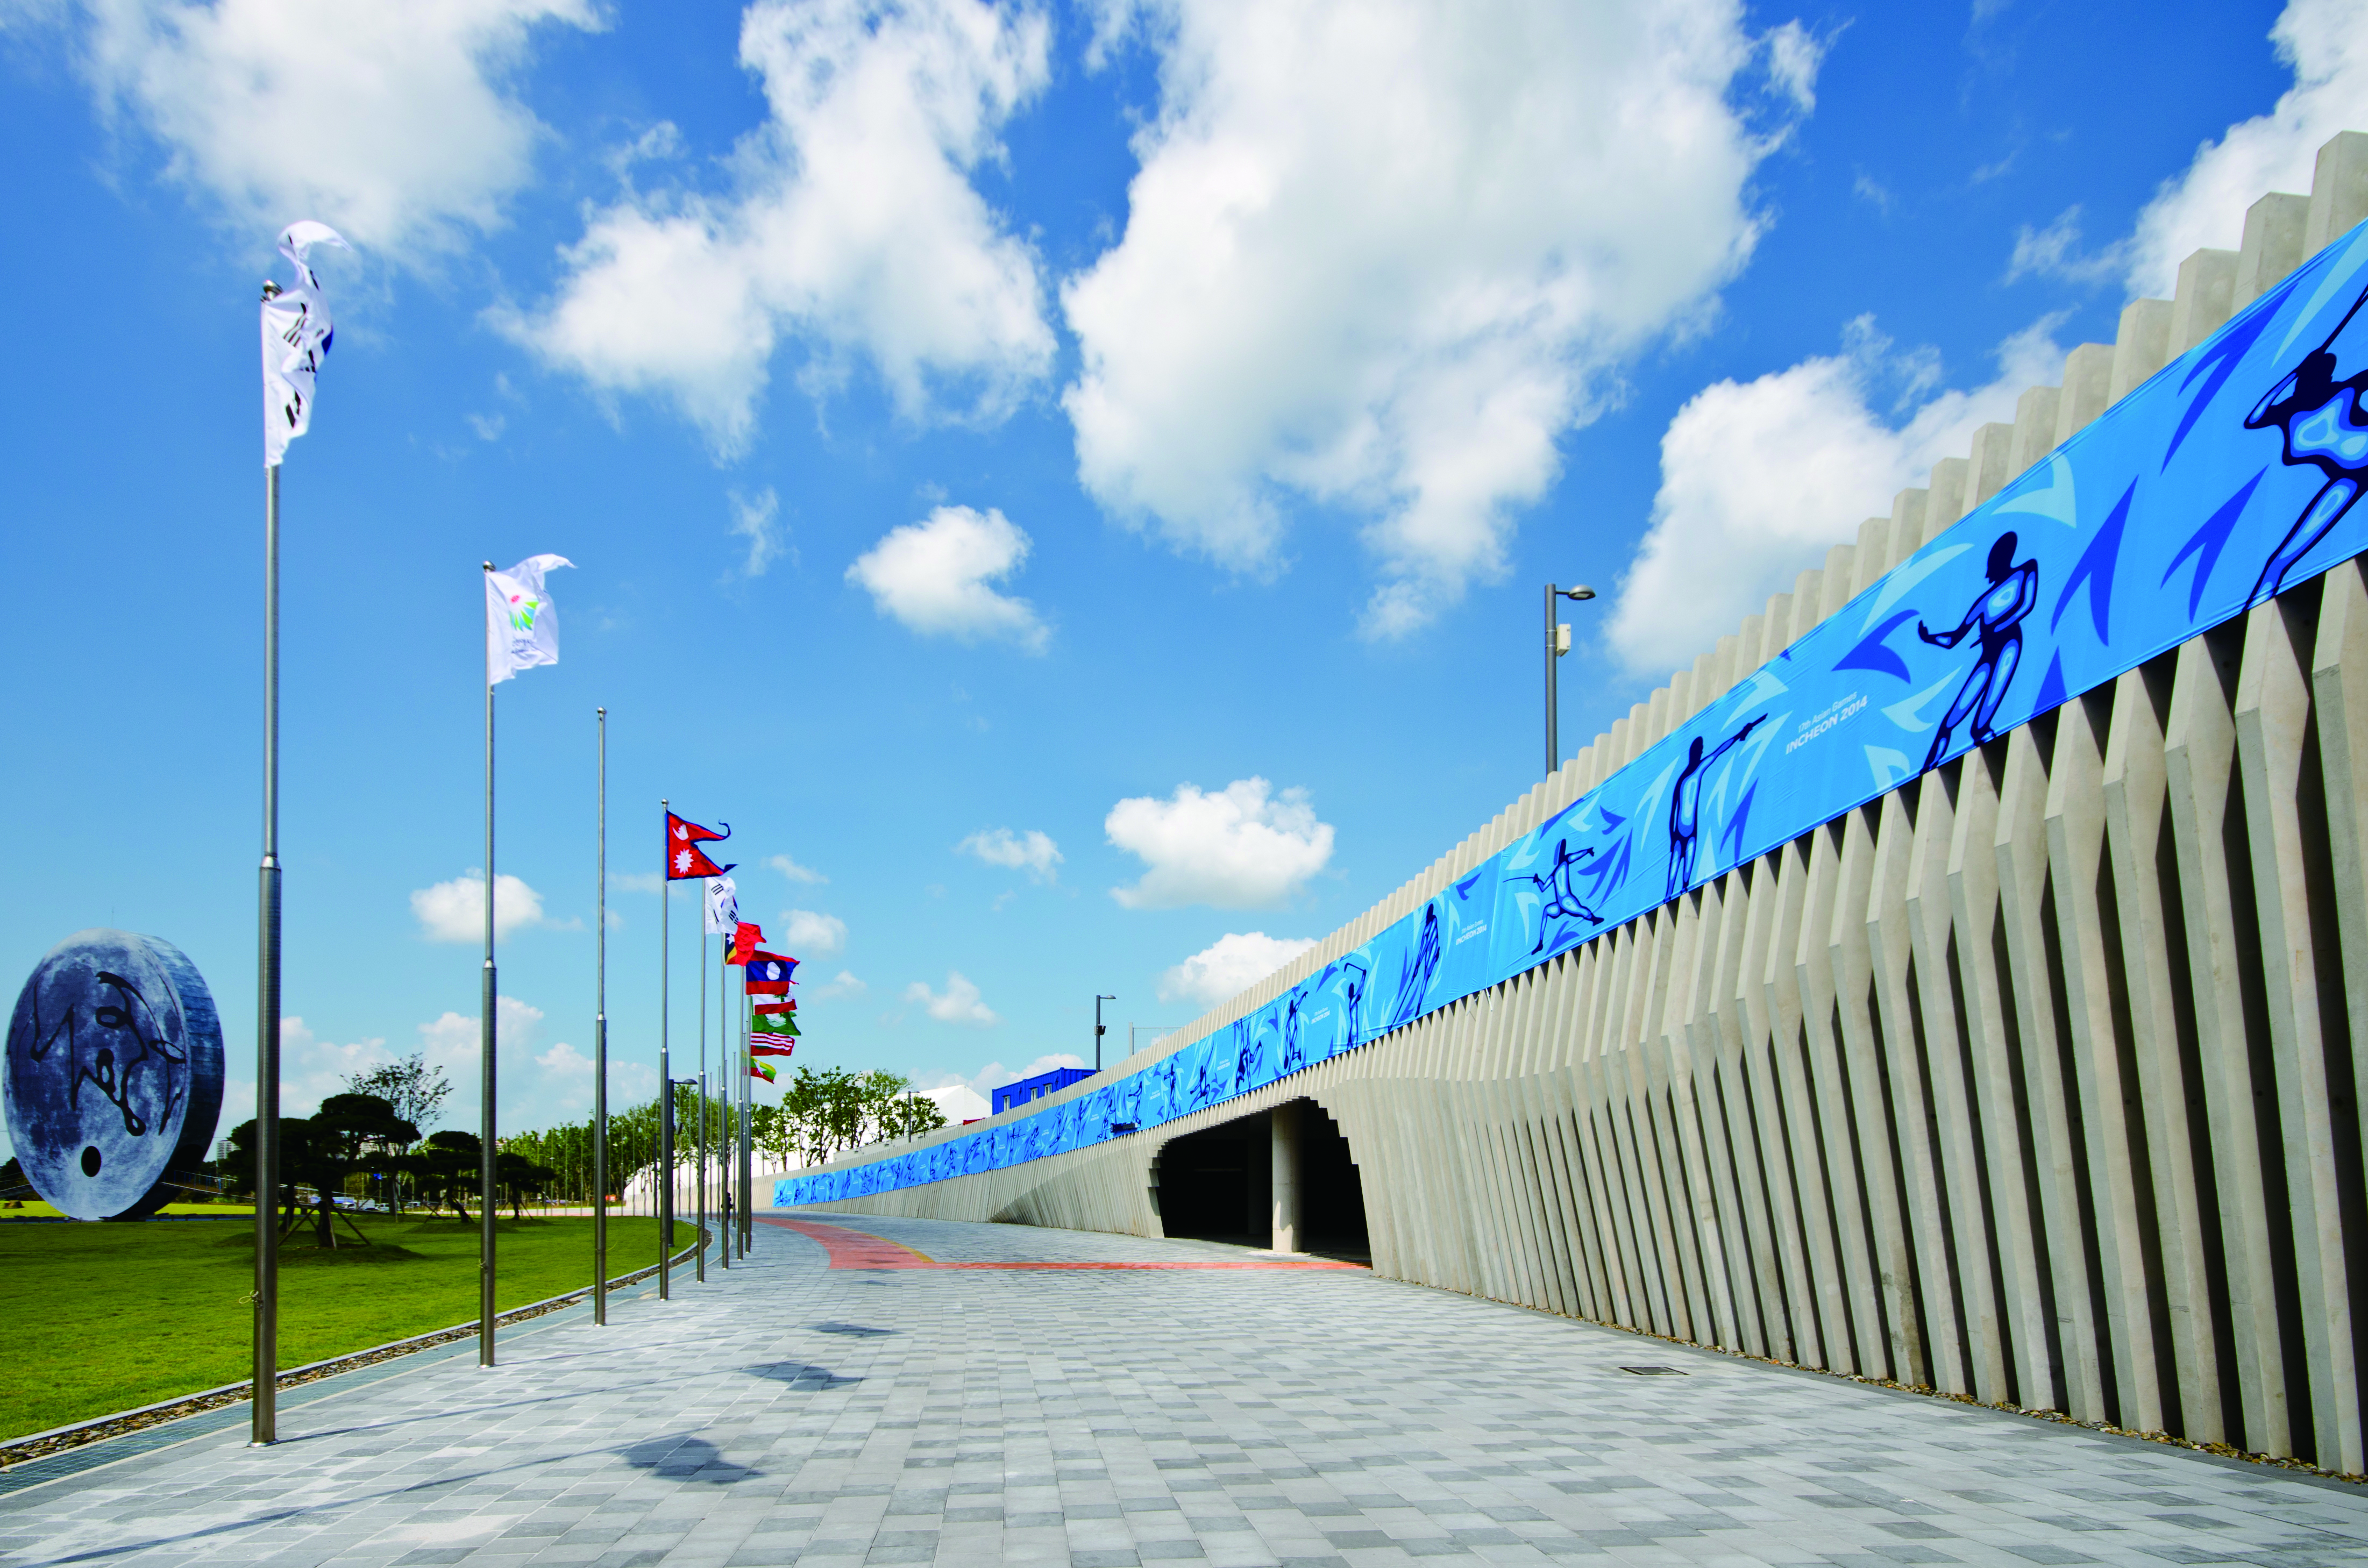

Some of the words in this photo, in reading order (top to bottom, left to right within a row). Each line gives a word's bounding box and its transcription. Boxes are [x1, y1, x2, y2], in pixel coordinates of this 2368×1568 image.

[1786, 713, 1838, 755] INCHEON
[1840, 695, 1868, 722] 2014
[1798, 719, 1811, 733] 17th
[1811, 708, 1831, 725] Asian
[1832, 691, 1857, 712] Games
[1455, 929, 1476, 945] INCHEON
[1476, 924, 1487, 935] 2014
